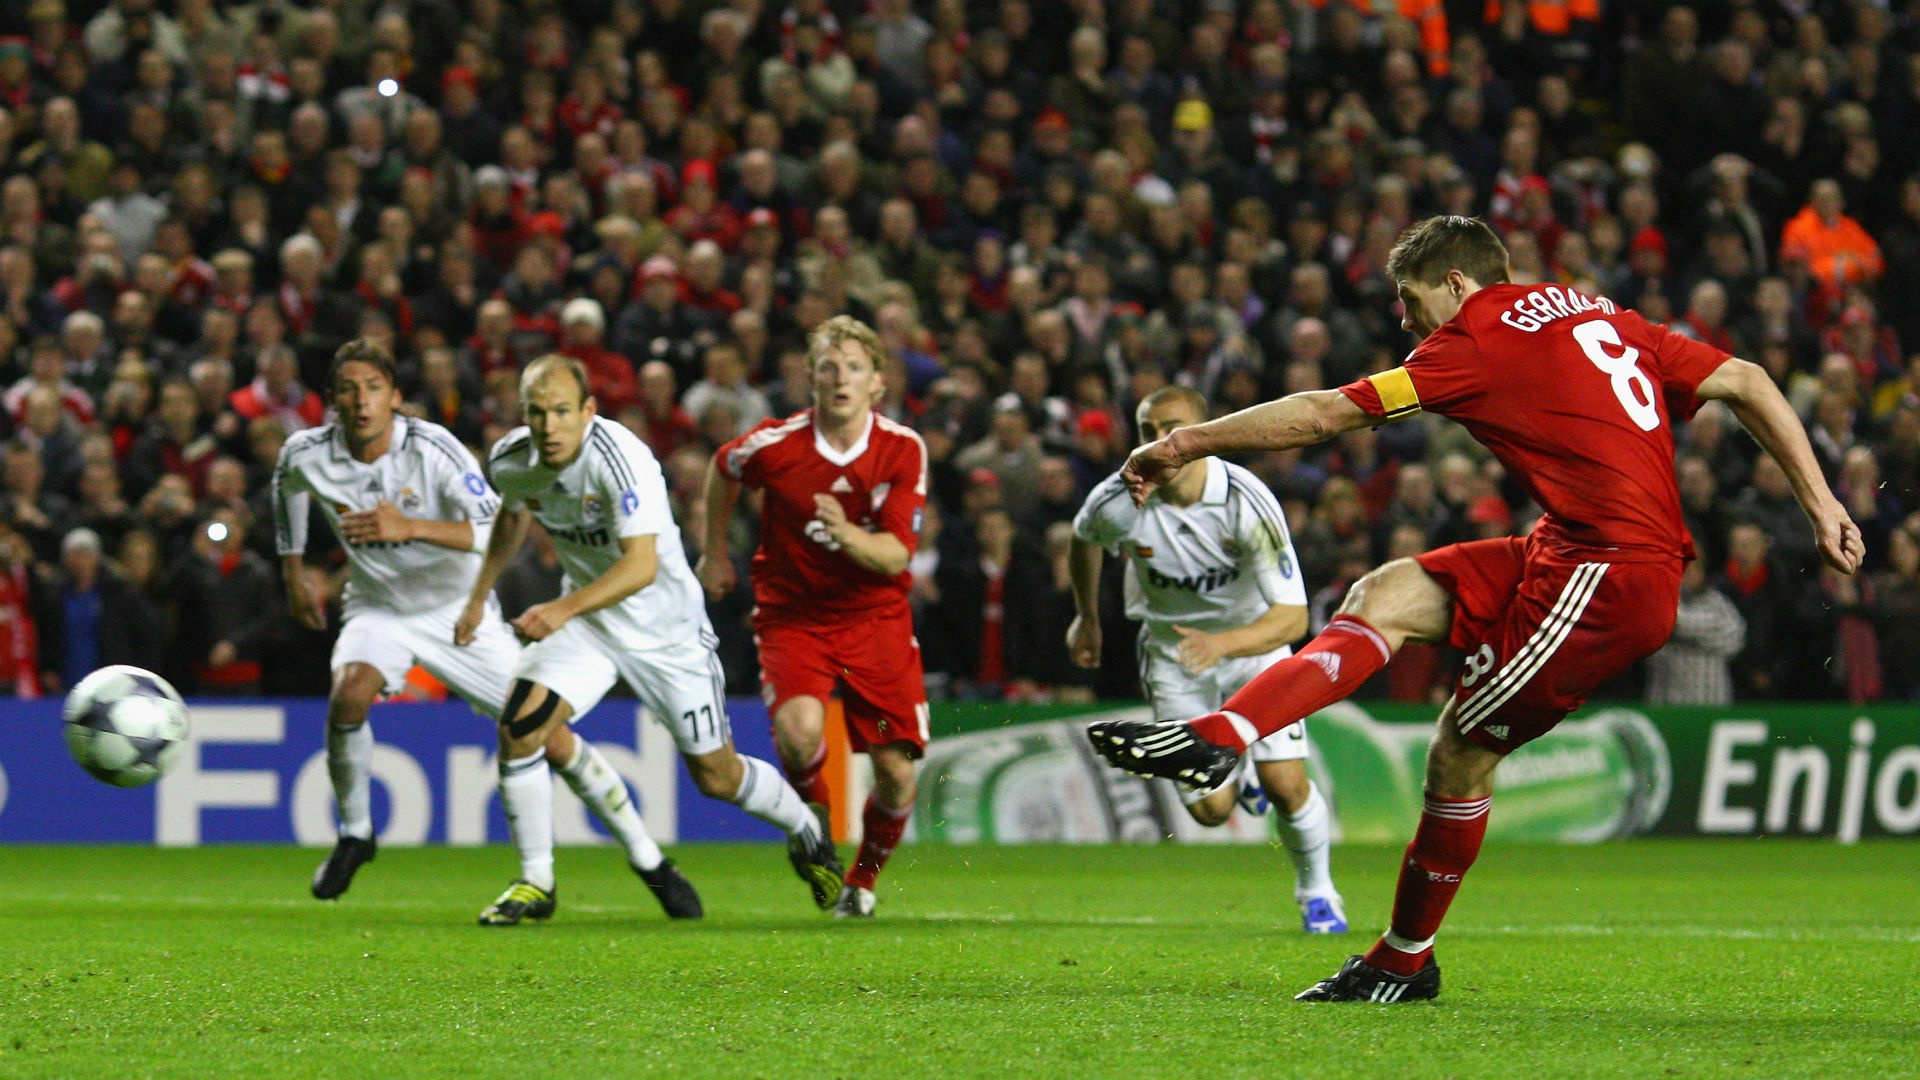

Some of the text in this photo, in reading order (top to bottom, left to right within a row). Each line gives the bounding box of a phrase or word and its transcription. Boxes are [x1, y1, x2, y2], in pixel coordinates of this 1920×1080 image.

[1571, 319, 1661, 432] 8
[1462, 643, 1495, 688] 8
[154, 706, 679, 846] Ford
[683, 704, 715, 743] 11
[1697, 717, 1920, 845] Enjo
